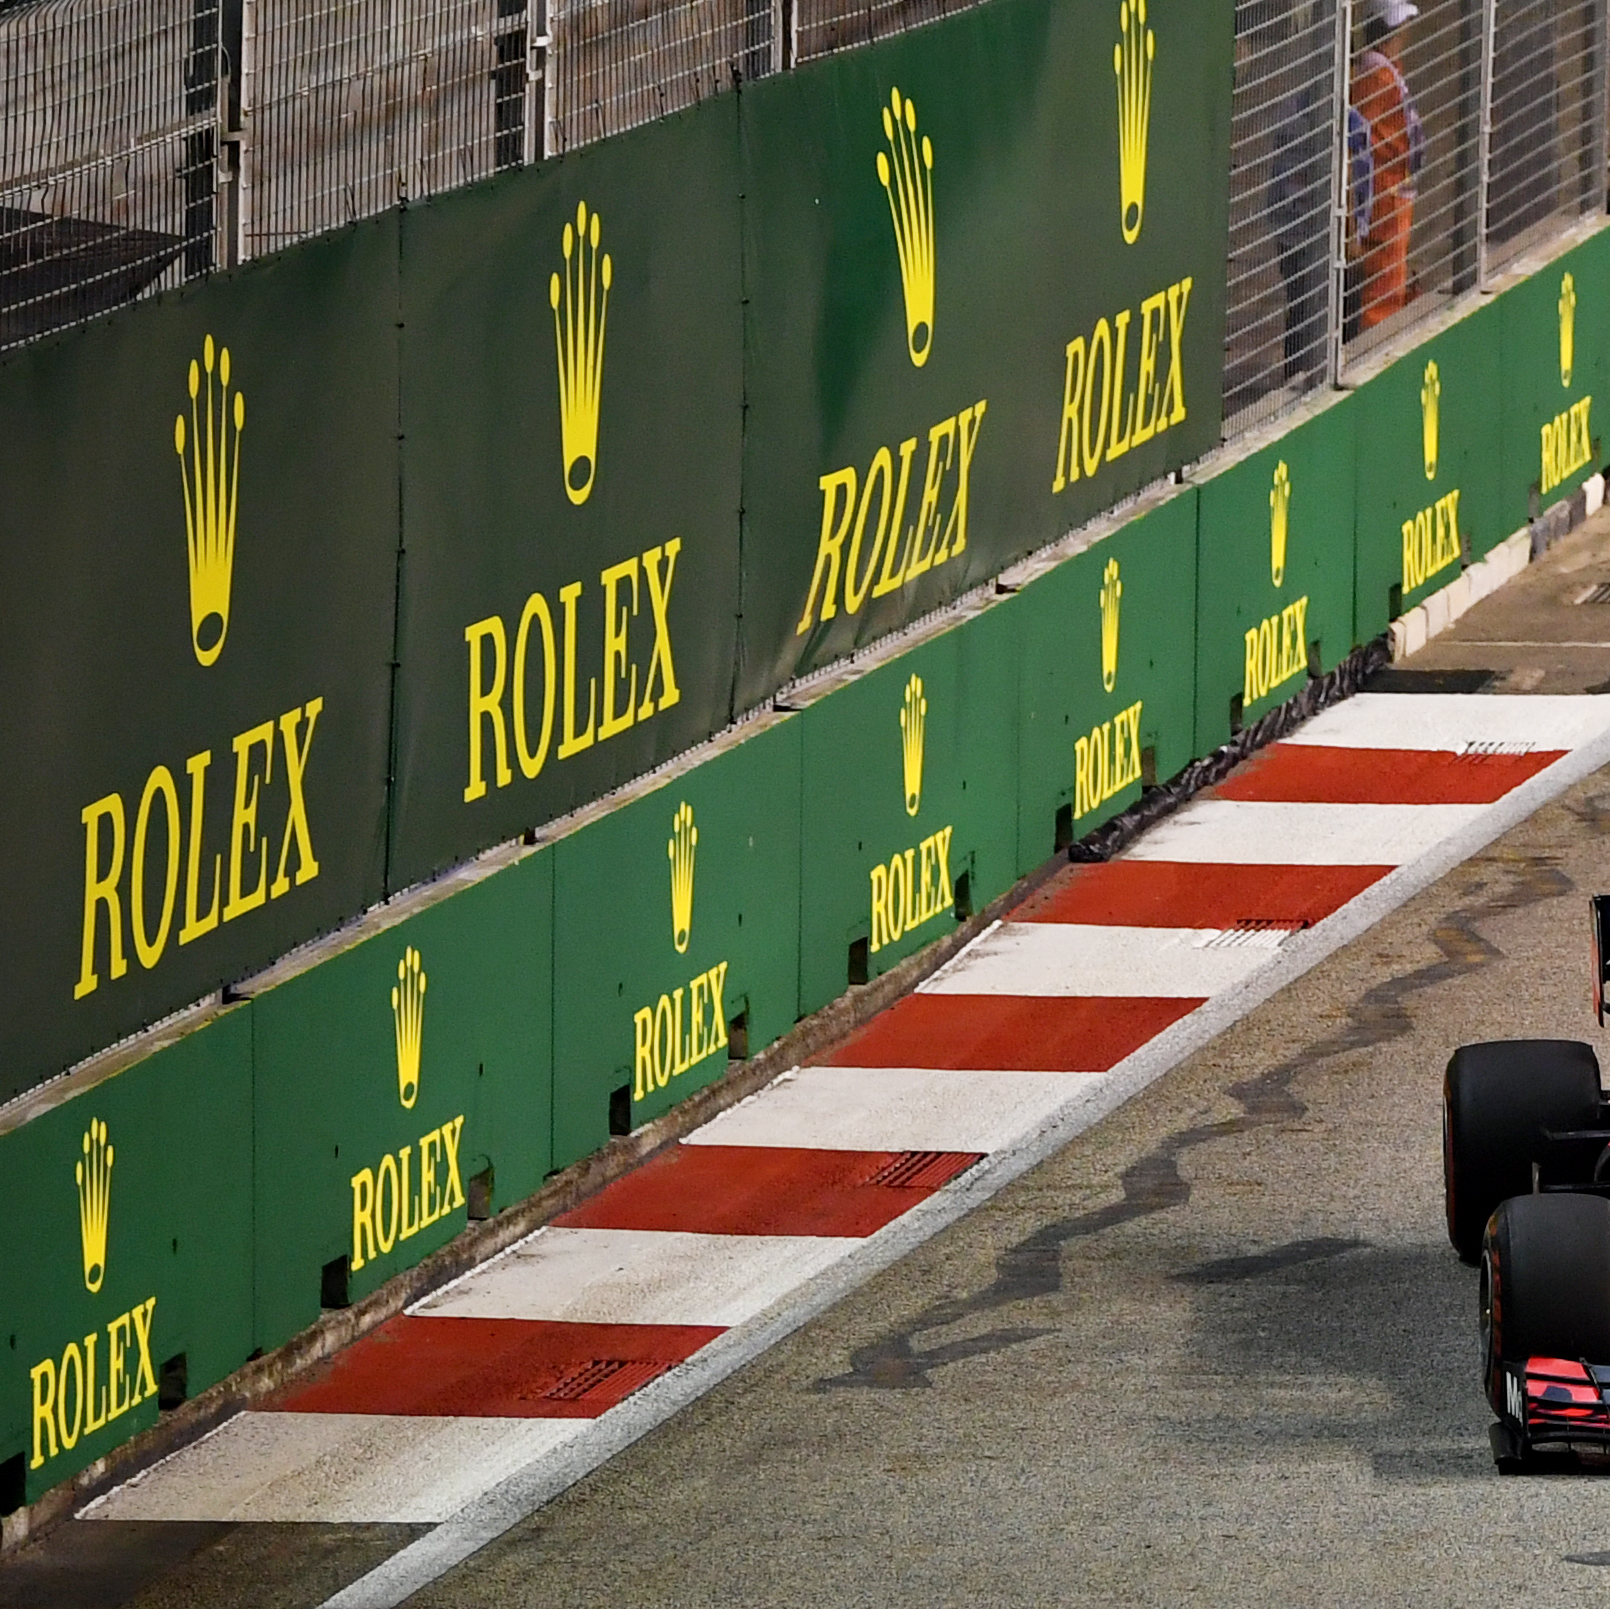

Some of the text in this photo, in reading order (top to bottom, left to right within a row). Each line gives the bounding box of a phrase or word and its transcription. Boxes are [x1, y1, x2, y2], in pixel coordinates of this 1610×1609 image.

[1052, 277, 1193, 494] ROLEX
[1541, 395, 1593, 494] ROLEX
[797, 399, 988, 637] ROLEX
[1402, 488, 1463, 595] ROLEX
[464, 537, 682, 803] ROLEX
[1243, 596, 1309, 707] ROLEX
[1073, 700, 1143, 820] ROLEX
[74, 696, 324, 1001] ROLEX
[870, 825, 954, 954] ROLEX
[634, 961, 728, 1102] ROLEX
[351, 1114, 466, 1272] ROLEX
[29, 1296, 158, 1470] ROLEX
